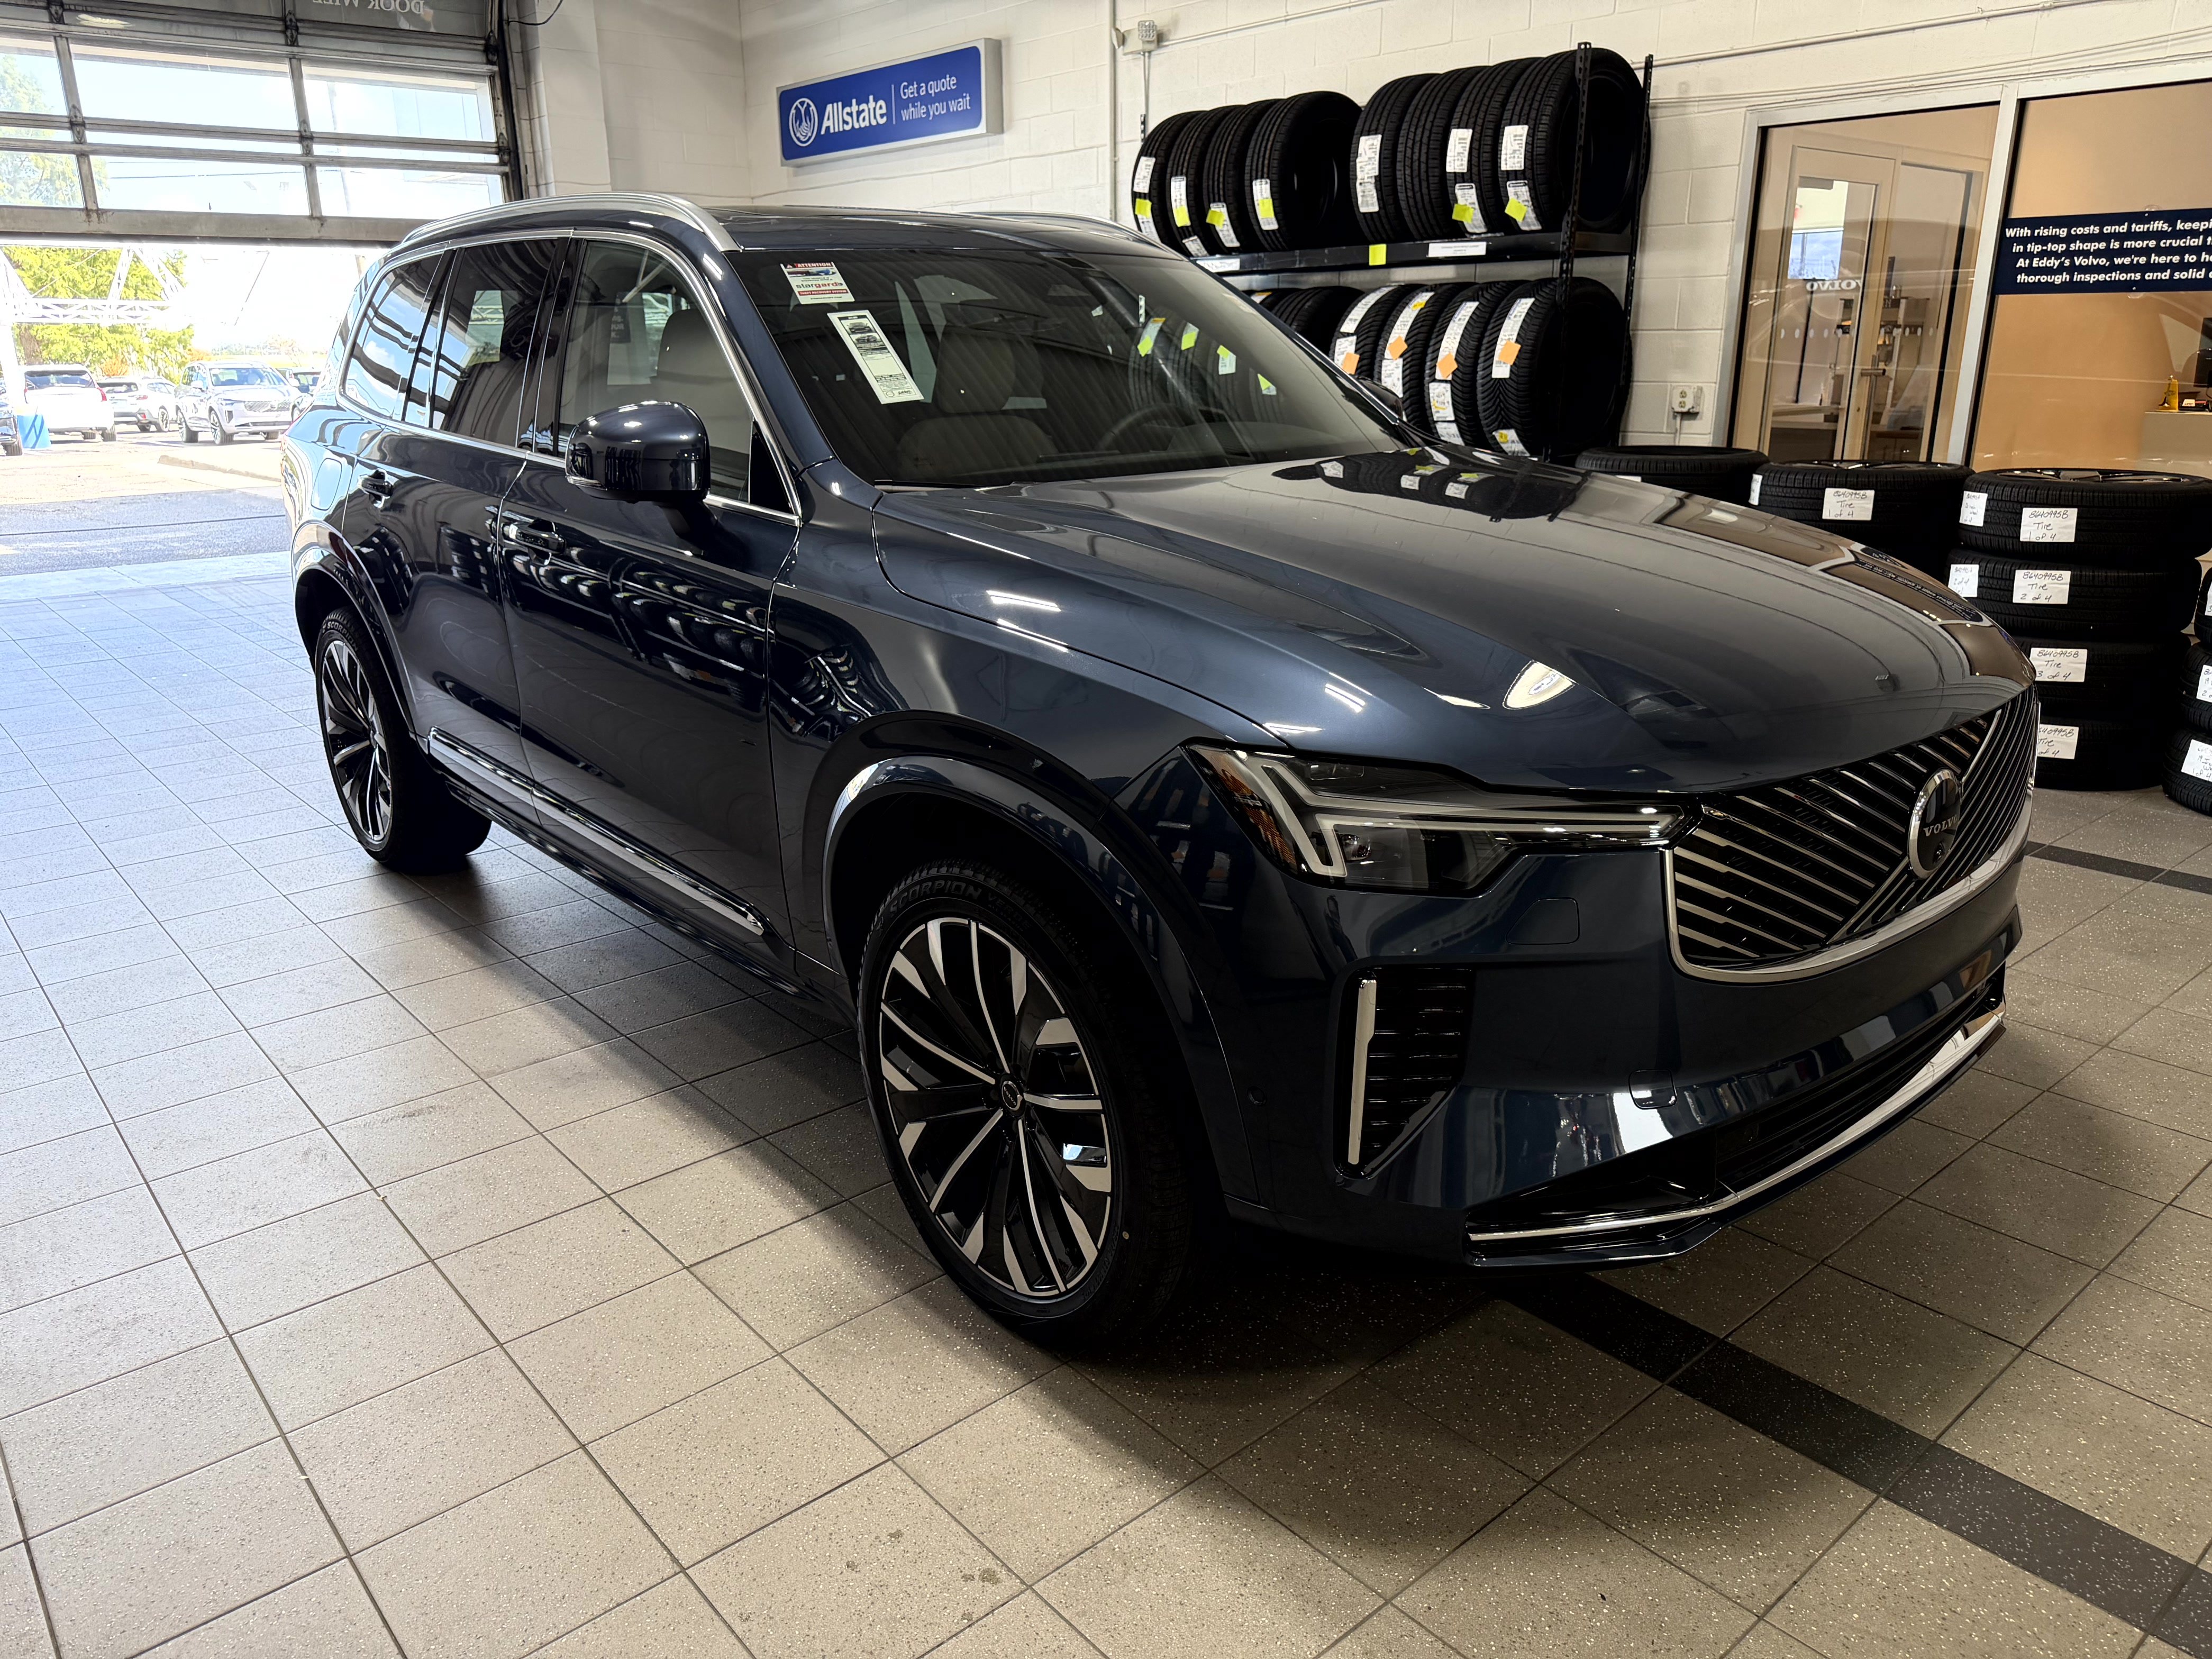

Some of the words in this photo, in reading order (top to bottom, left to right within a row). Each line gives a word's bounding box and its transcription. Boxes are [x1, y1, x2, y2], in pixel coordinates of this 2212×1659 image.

[900, 81, 918, 99] Get
[920, 83, 926, 95] a
[927, 74, 957, 97] quote
[821, 95, 887, 135] Allstate
[901, 101, 927, 121] while
[929, 102, 946, 120] you
[949, 93, 971, 112] wait
[2005, 227, 2031, 238] With
[2034, 226, 2068, 238] rising
[2071, 225, 2100, 235] costs
[2103, 222, 2128, 233] and
[2131, 220, 2172, 232] tariffs,
[2013, 243, 2024, 252] in
[2027, 242, 2067, 254] tip-top
[2069, 240, 2107, 252] shape
[2109, 239, 2120, 249] is
[2123, 240, 2156, 248] more
[2160, 235, 2204, 247] crucial
[2016, 258, 2030, 268] At
[2033, 257, 2070, 269] Eddy's
[2074, 256, 2110, 267] Volvo,
[2114, 254, 2147, 265] we're
[2150, 253, 2180, 264] here
[2184, 253, 2197, 263] to
[2017, 272, 2070, 284] thorough
[2073, 270, 2141, 284] inspections
[2145, 269, 2170, 280] and
[2173, 268, 2205, 279] solid
[1836, 500, 1855, 508] Tire
[1834, 509, 1843, 517] of
[2033, 522, 2053, 531] Tire
[2023, 571, 2063, 581] 8640995B
[327, 621, 359, 652] SCORPION
[2037, 650, 2079, 658] 8640995B
[2045, 659, 2062, 668] Tire
[2063, 672, 2071, 681] 4
[2206, 772, 2211, 781] 4
[1923, 815, 1959, 837] VOLVO
[890, 880, 982, 913] SCORPION
